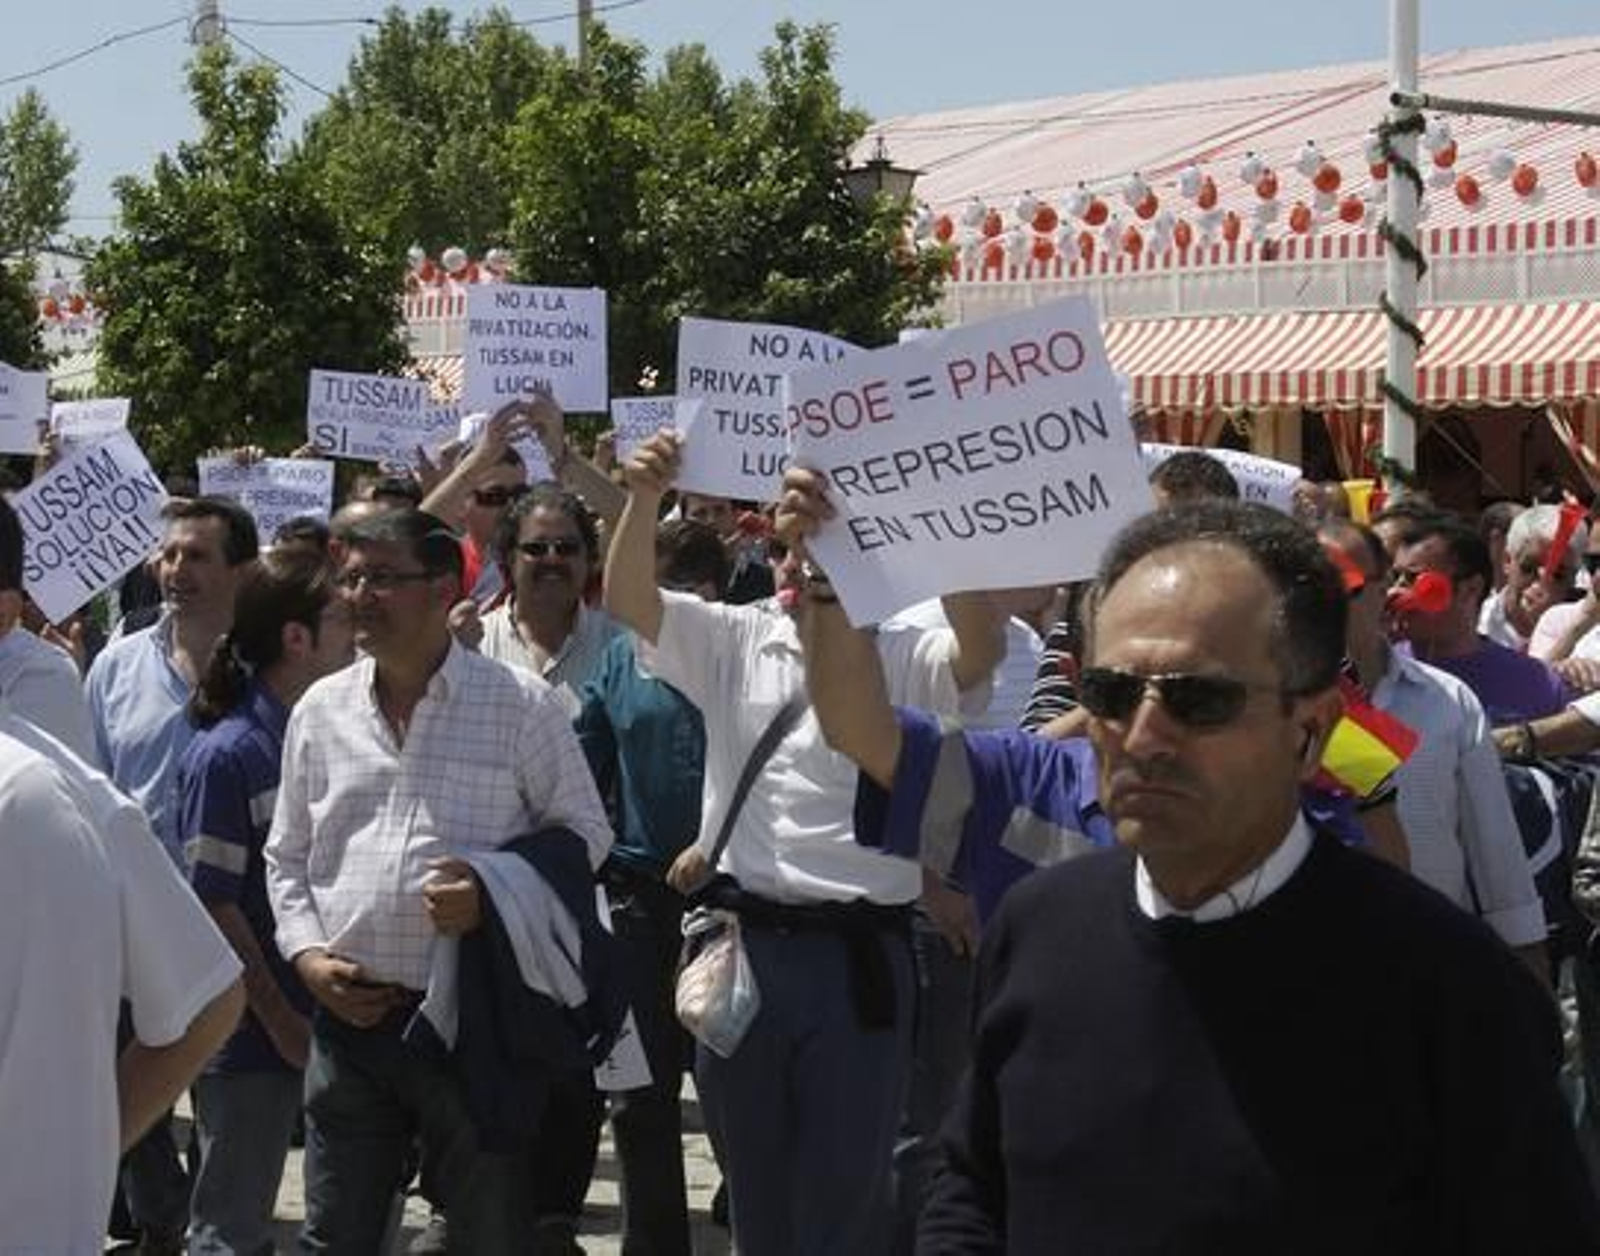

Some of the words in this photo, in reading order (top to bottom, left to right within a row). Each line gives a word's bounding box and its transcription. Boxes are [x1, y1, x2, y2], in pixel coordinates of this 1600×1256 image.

[495, 290, 521, 309] NO
[525, 291, 539, 309] A
[542, 292, 567, 312] LA
[479, 348, 544, 365] TUSSAM
[548, 349, 573, 368] EN
[750, 334, 790, 358] NO
[798, 338, 815, 361] A
[322, 376, 421, 412] TUSSAM
[787, 382, 894, 438] PSOE
[948, 330, 1086, 400] PARO
[313, 423, 348, 454] SI
[714, 409, 787, 438] TUSS
[831, 400, 1110, 497] REPRESION
[18, 448, 122, 533] USSAM
[23, 468, 161, 583] SOLUCION
[848, 514, 914, 551] EN
[911, 473, 1111, 543] TUSSAM
